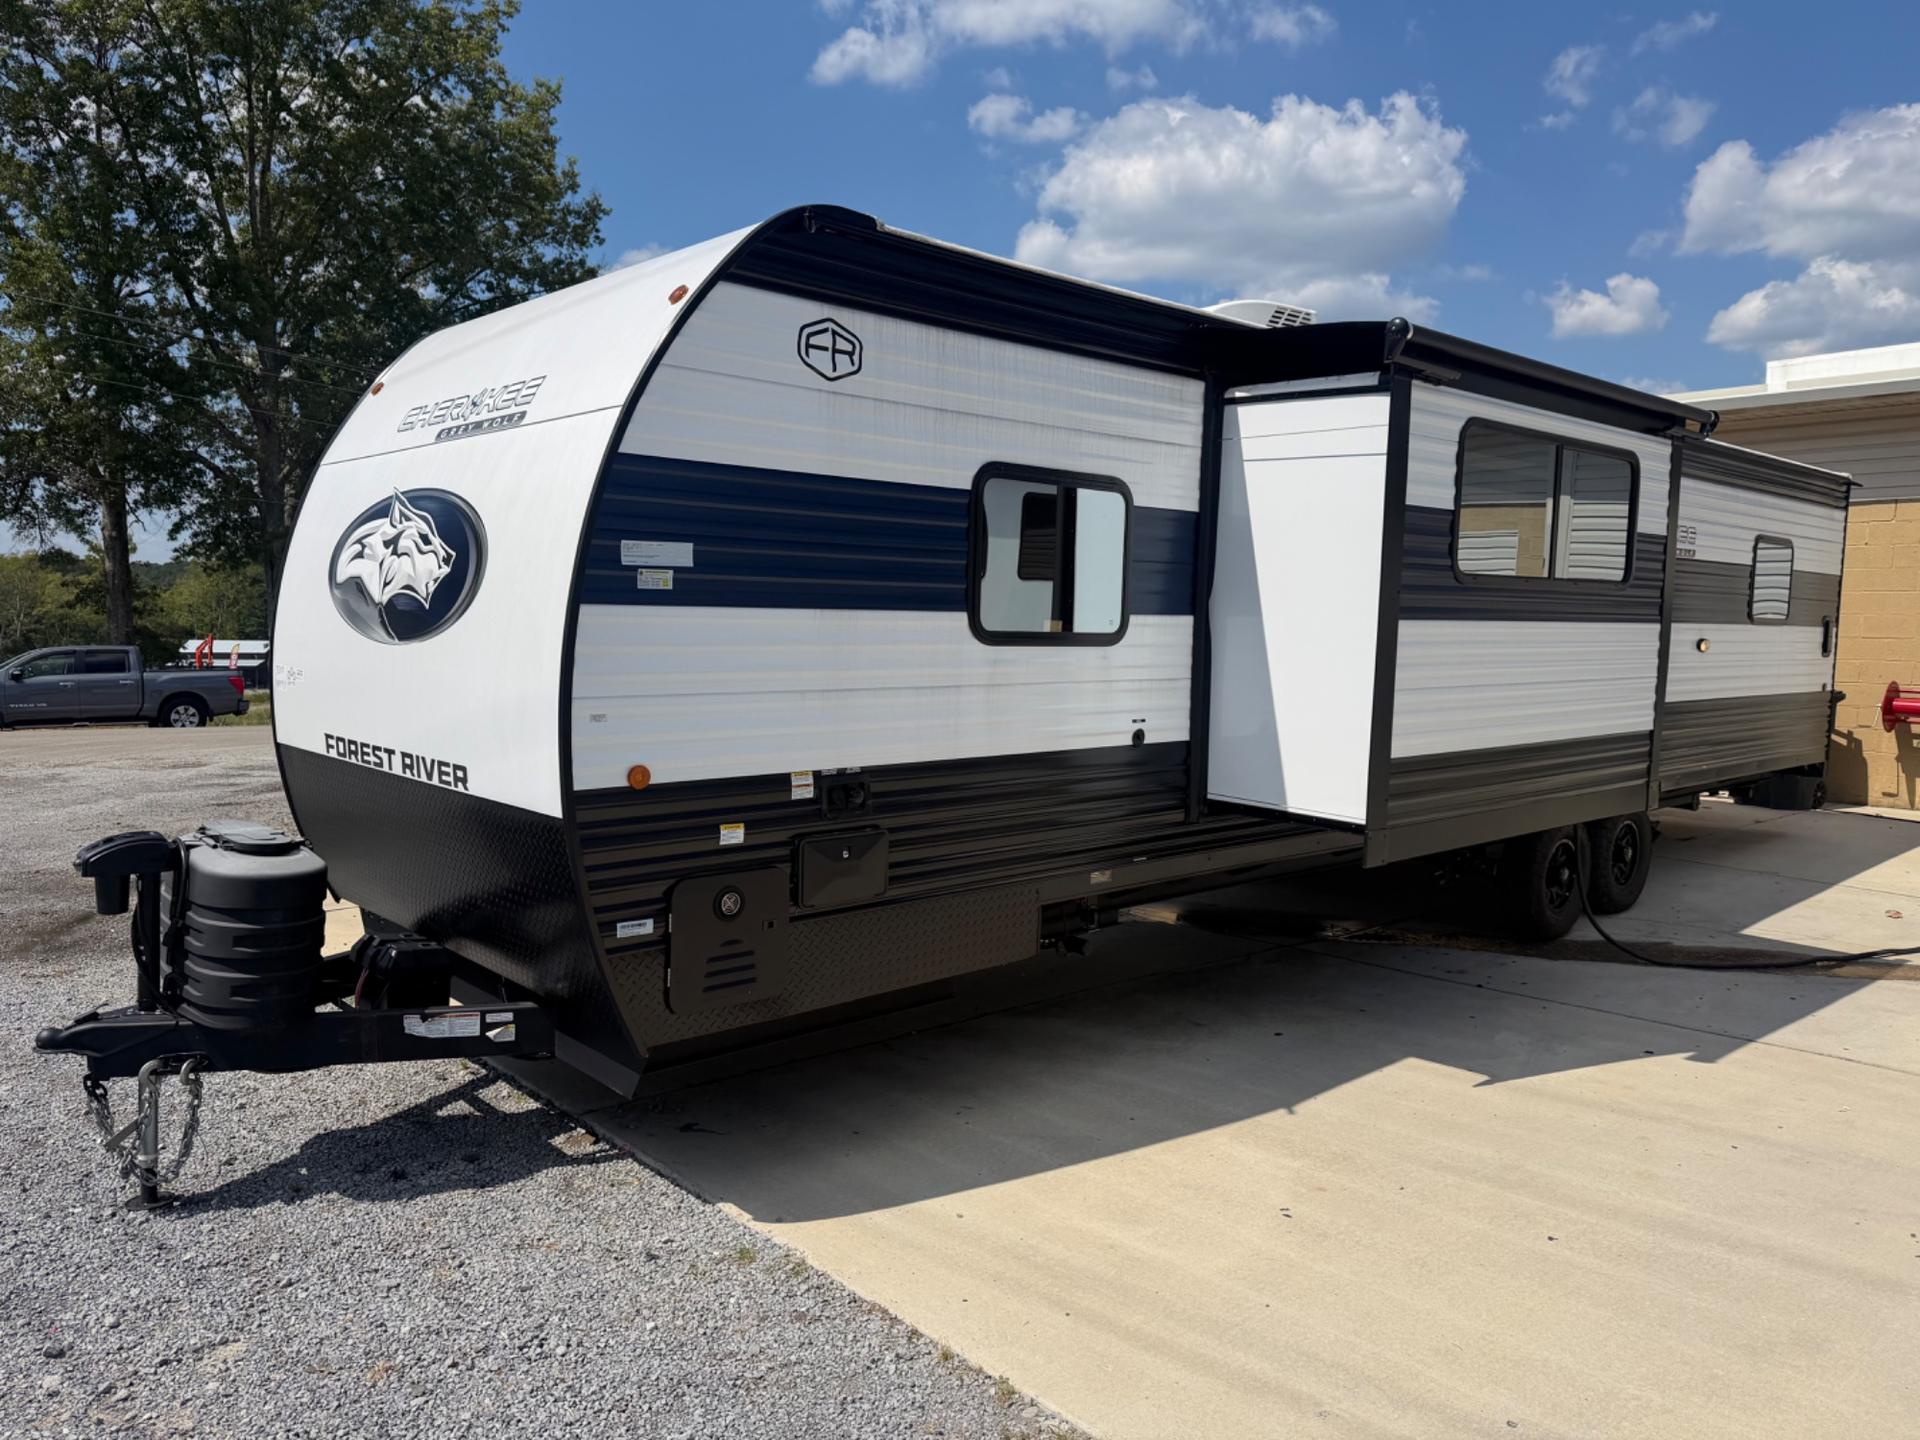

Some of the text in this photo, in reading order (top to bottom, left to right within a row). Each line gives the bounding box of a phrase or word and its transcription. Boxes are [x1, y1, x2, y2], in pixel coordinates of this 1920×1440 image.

[439, 412, 522, 440] GREY WOLF
[323, 732, 470, 792] FOREST RIVER
